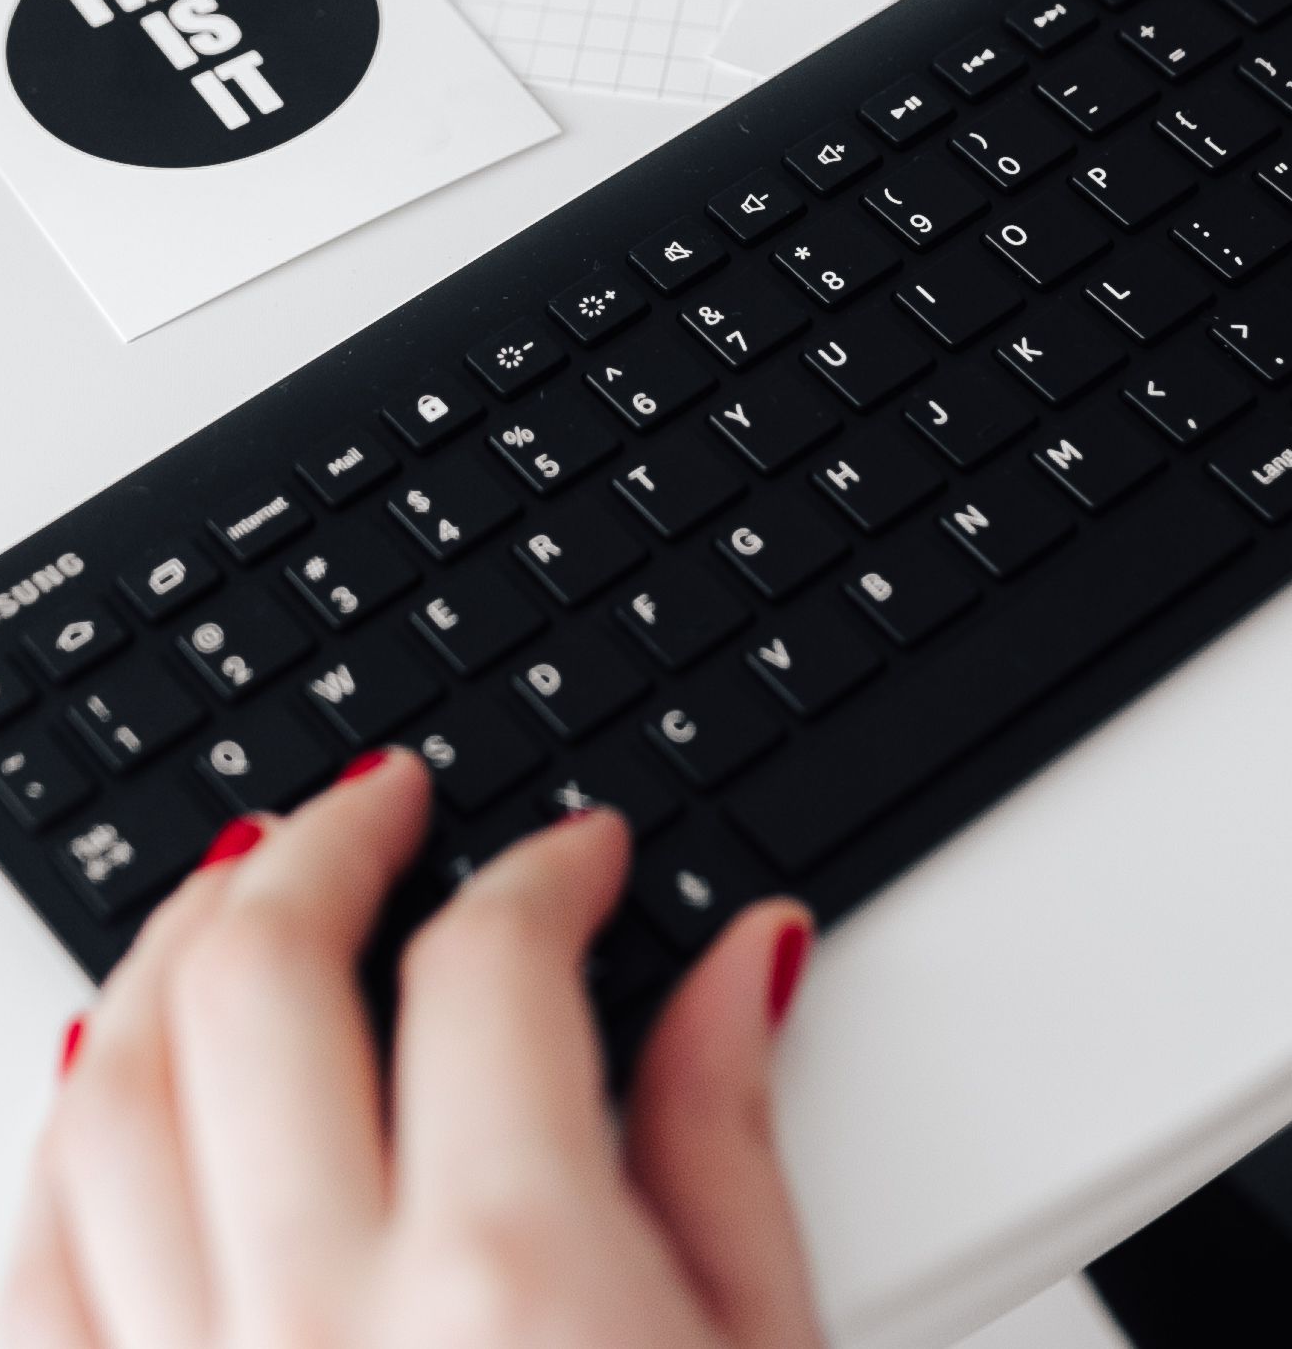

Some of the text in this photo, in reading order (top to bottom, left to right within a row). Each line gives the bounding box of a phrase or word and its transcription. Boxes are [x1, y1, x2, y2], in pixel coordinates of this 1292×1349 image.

[190, 49, 285, 131] IT
[1086, 167, 1107, 189] P
[1102, 282, 1131, 300] L
[817, 341, 848, 367] U
[1012, 336, 1044, 363] K
[723, 403, 751, 428] Y
[928, 400, 949, 425] J
[327, 446, 364, 477] Mail
[1046, 439, 1084, 470] M
[627, 465, 655, 492] T
[826, 460, 860, 491] H
[953, 504, 989, 535] N
[528, 534, 562, 564] R
[731, 527, 764, 556] G
[860, 572, 893, 602] B
[426, 598, 458, 630] E
[760, 638, 791, 669] V
[311, 664, 356, 704] W
[661, 710, 696, 743] C
